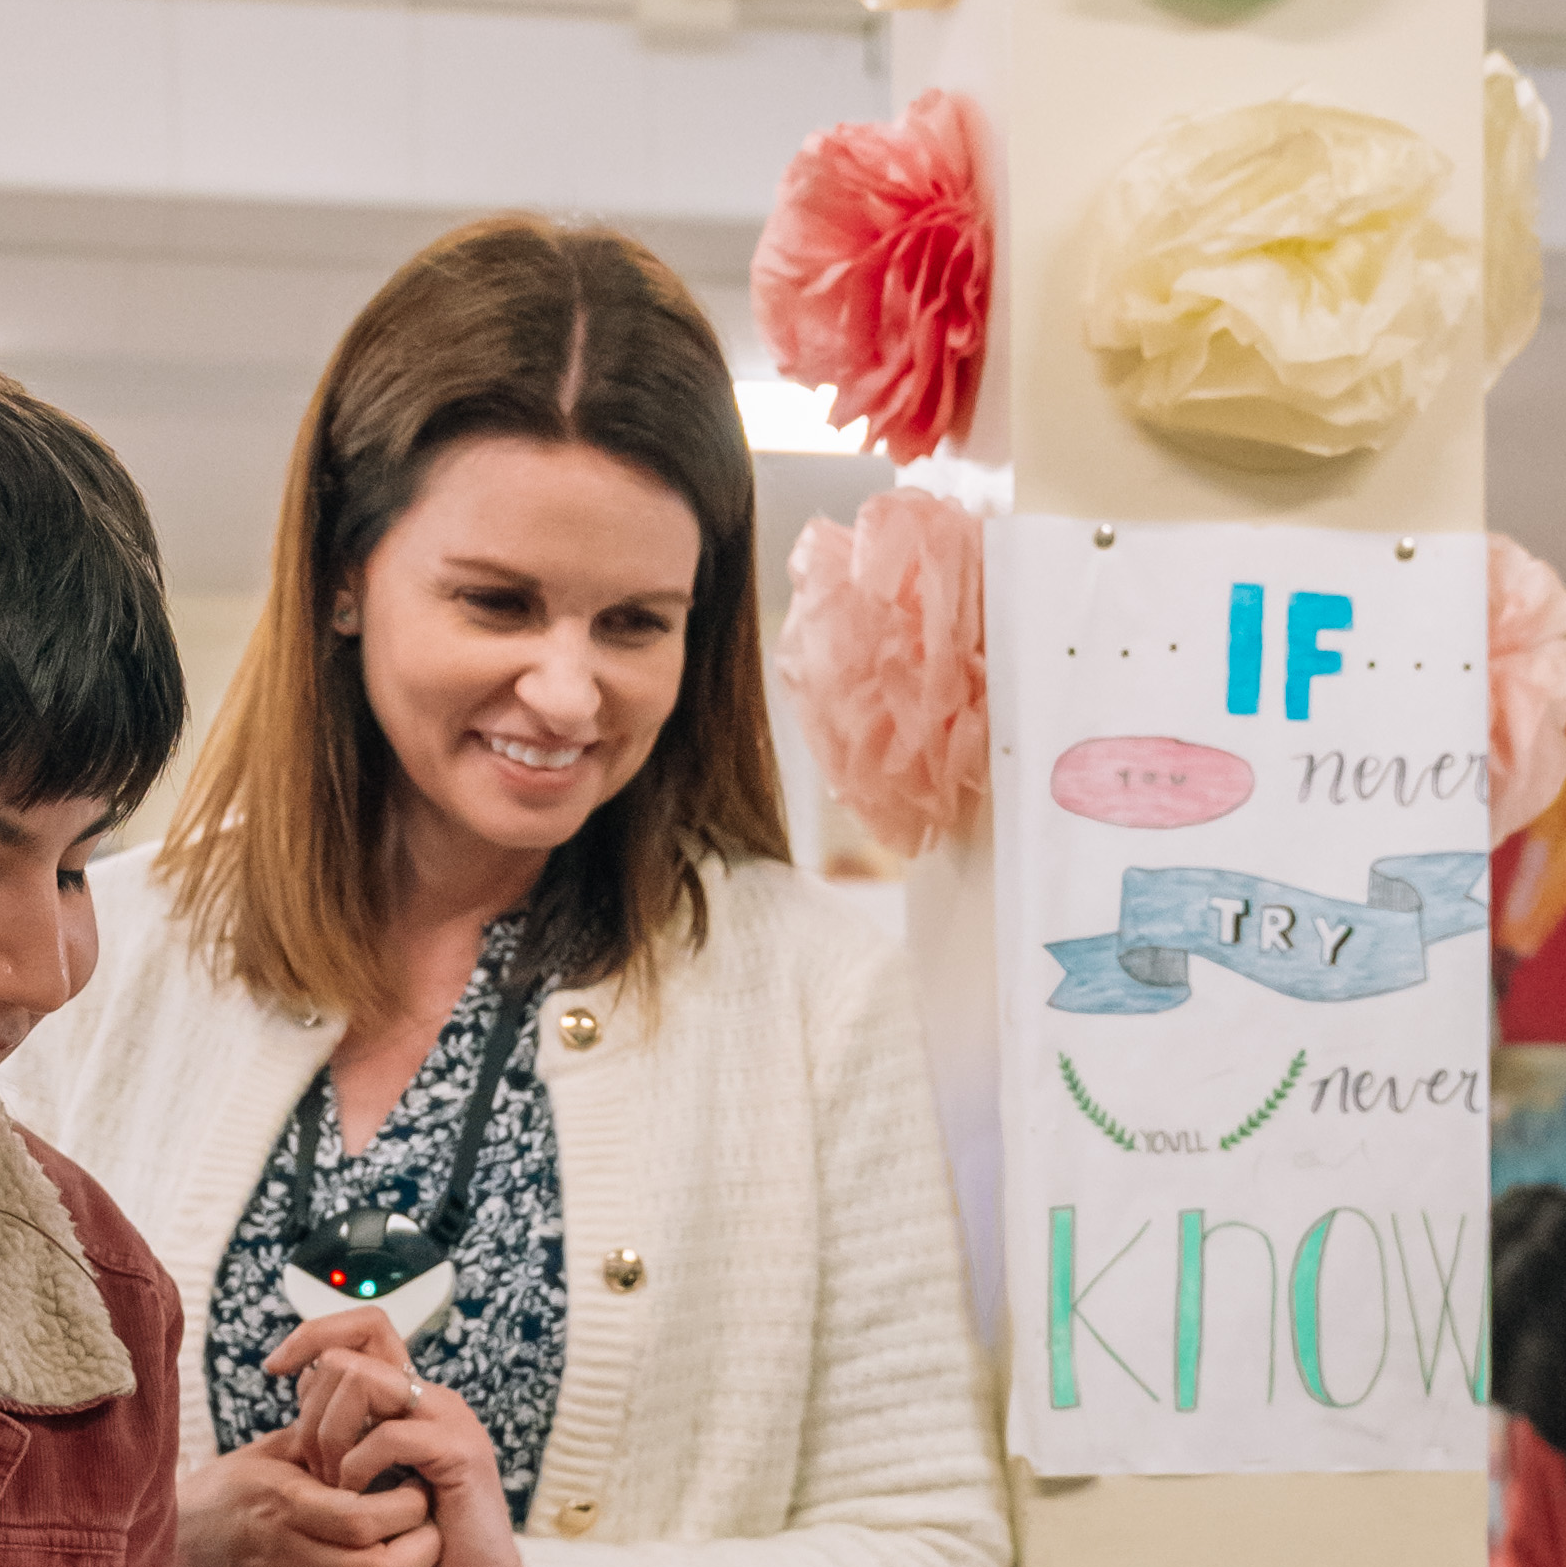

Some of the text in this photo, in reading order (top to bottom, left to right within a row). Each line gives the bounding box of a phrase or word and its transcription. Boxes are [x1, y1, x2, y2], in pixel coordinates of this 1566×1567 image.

[1226, 582, 1354, 721] IF
[1291, 750, 1489, 807] never
[1207, 896, 1353, 967] TRY
[1310, 1065, 1483, 1114] never
